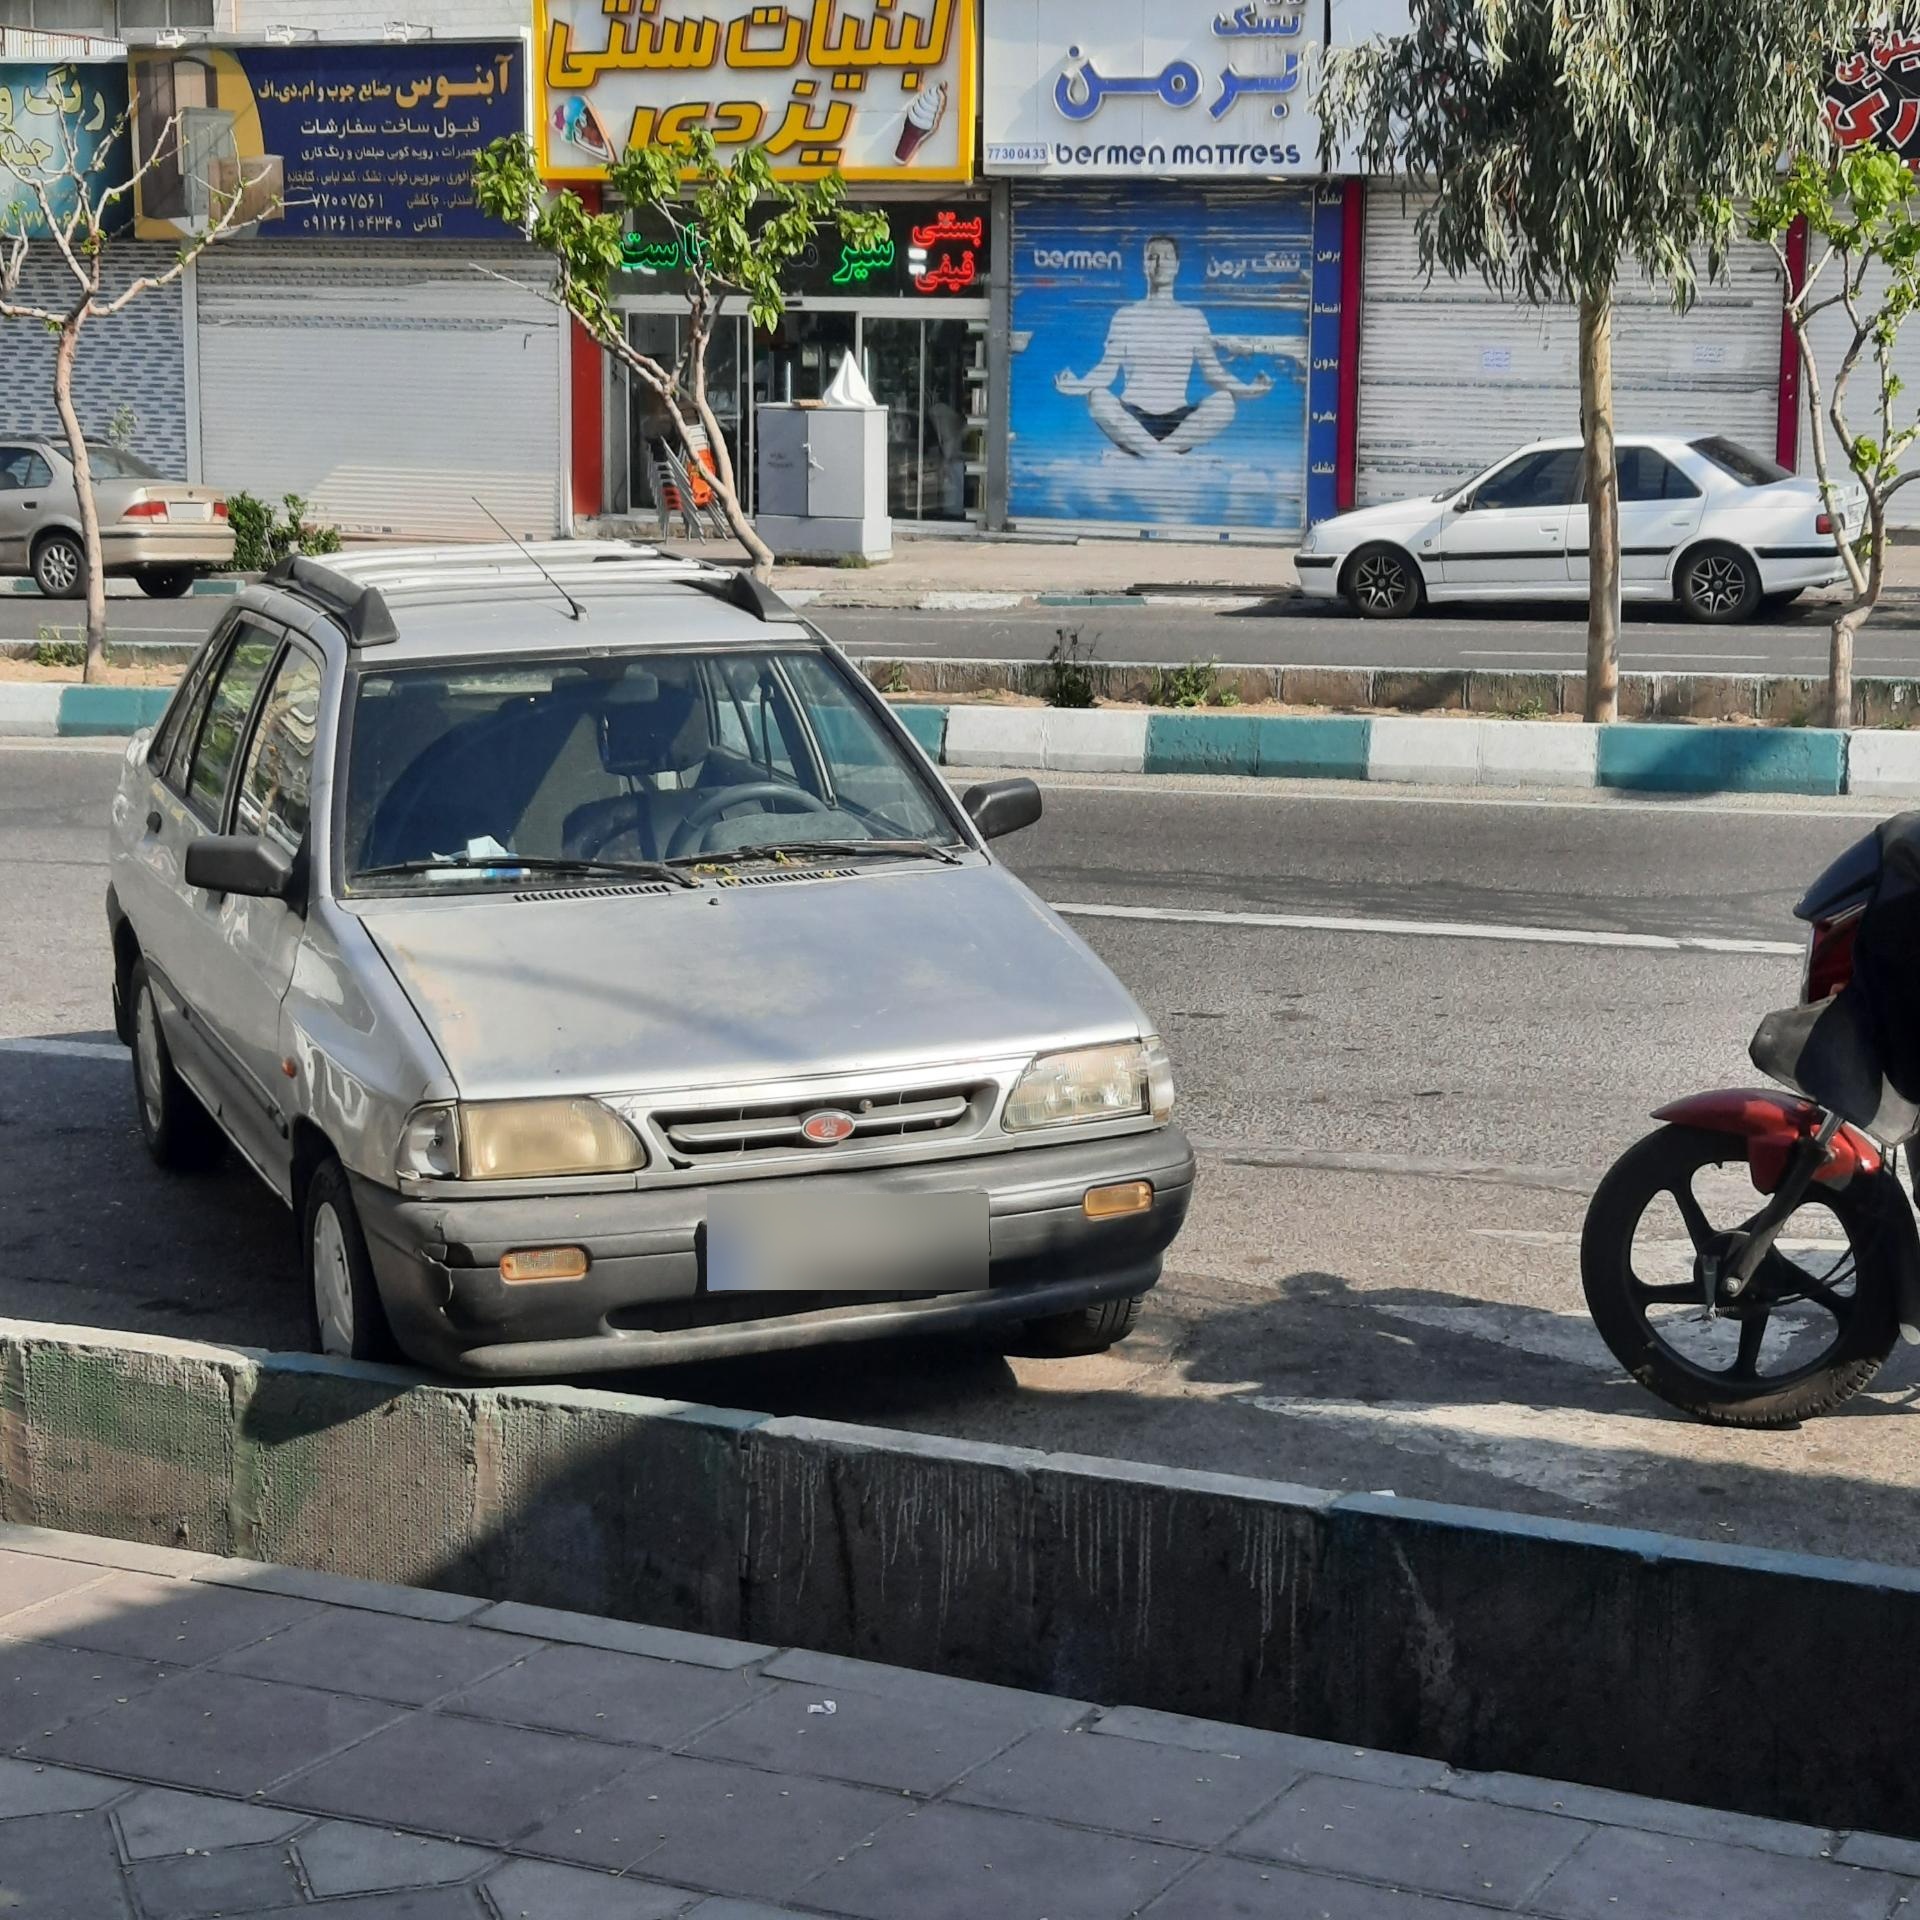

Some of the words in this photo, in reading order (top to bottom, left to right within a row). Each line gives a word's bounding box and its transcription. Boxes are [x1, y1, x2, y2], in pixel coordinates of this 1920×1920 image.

[726, 0, 953, 90] لبنیات
[396, 54, 513, 109] آبنوس
[1053, 45, 1302, 121] برمن
[317, 86, 324, 102] و
[300, 118, 377, 139] سفارشات
[381, 117, 430, 133] ساخت
[434, 116, 480, 138] قبول
[1056, 143, 1165, 164] bermen
[911, 210, 984, 249] بستنی
[1034, 249, 1122, 271] bermen
